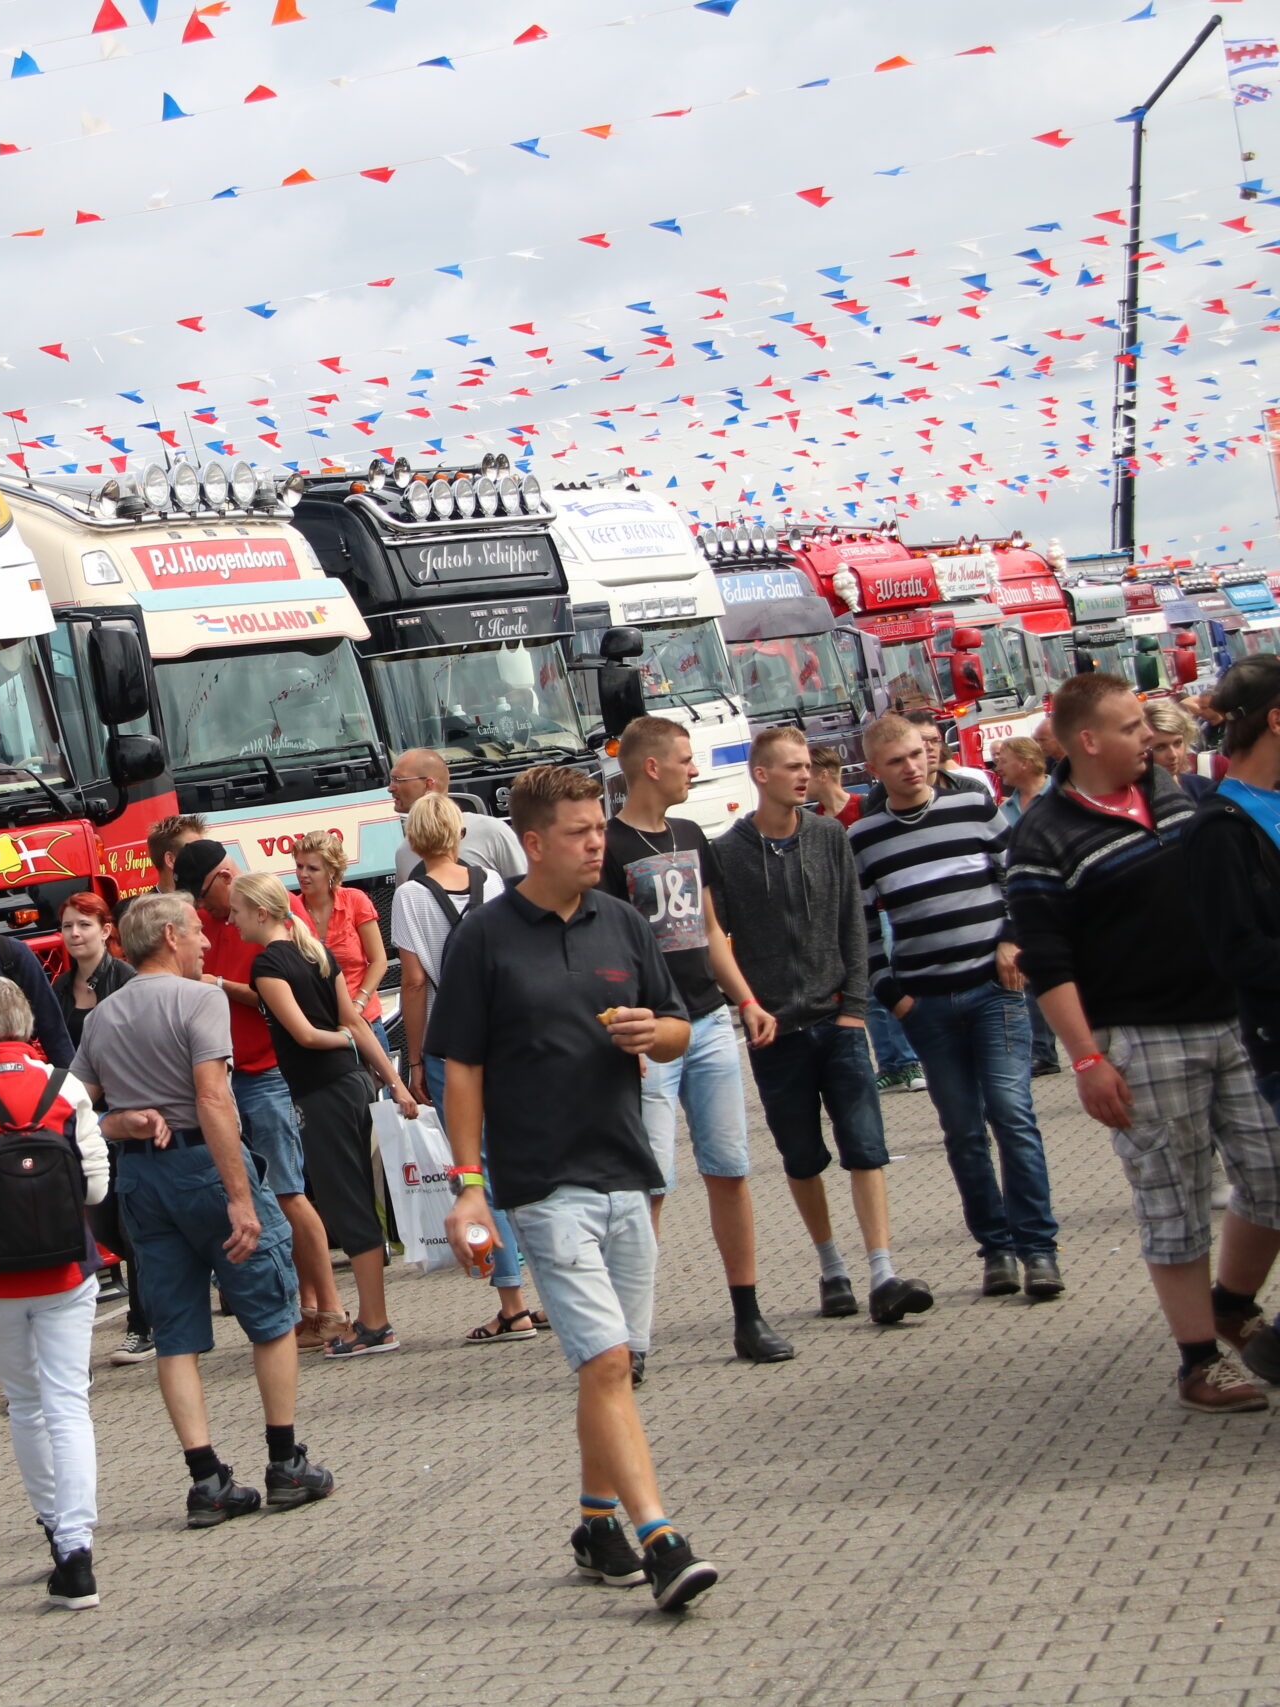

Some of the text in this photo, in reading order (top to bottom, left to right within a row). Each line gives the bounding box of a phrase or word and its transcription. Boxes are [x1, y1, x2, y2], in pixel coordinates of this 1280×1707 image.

[418, 541, 540, 580] Jakob Schipper
[722, 573, 803, 603] Edwin Salari
[876, 576, 928, 603] Weeda
[226, 610, 309, 635] HOLLAND
[487, 616, 528, 638] Harde
[977, 725, 1013, 740] OLVO
[649, 868, 703, 922] J&J
